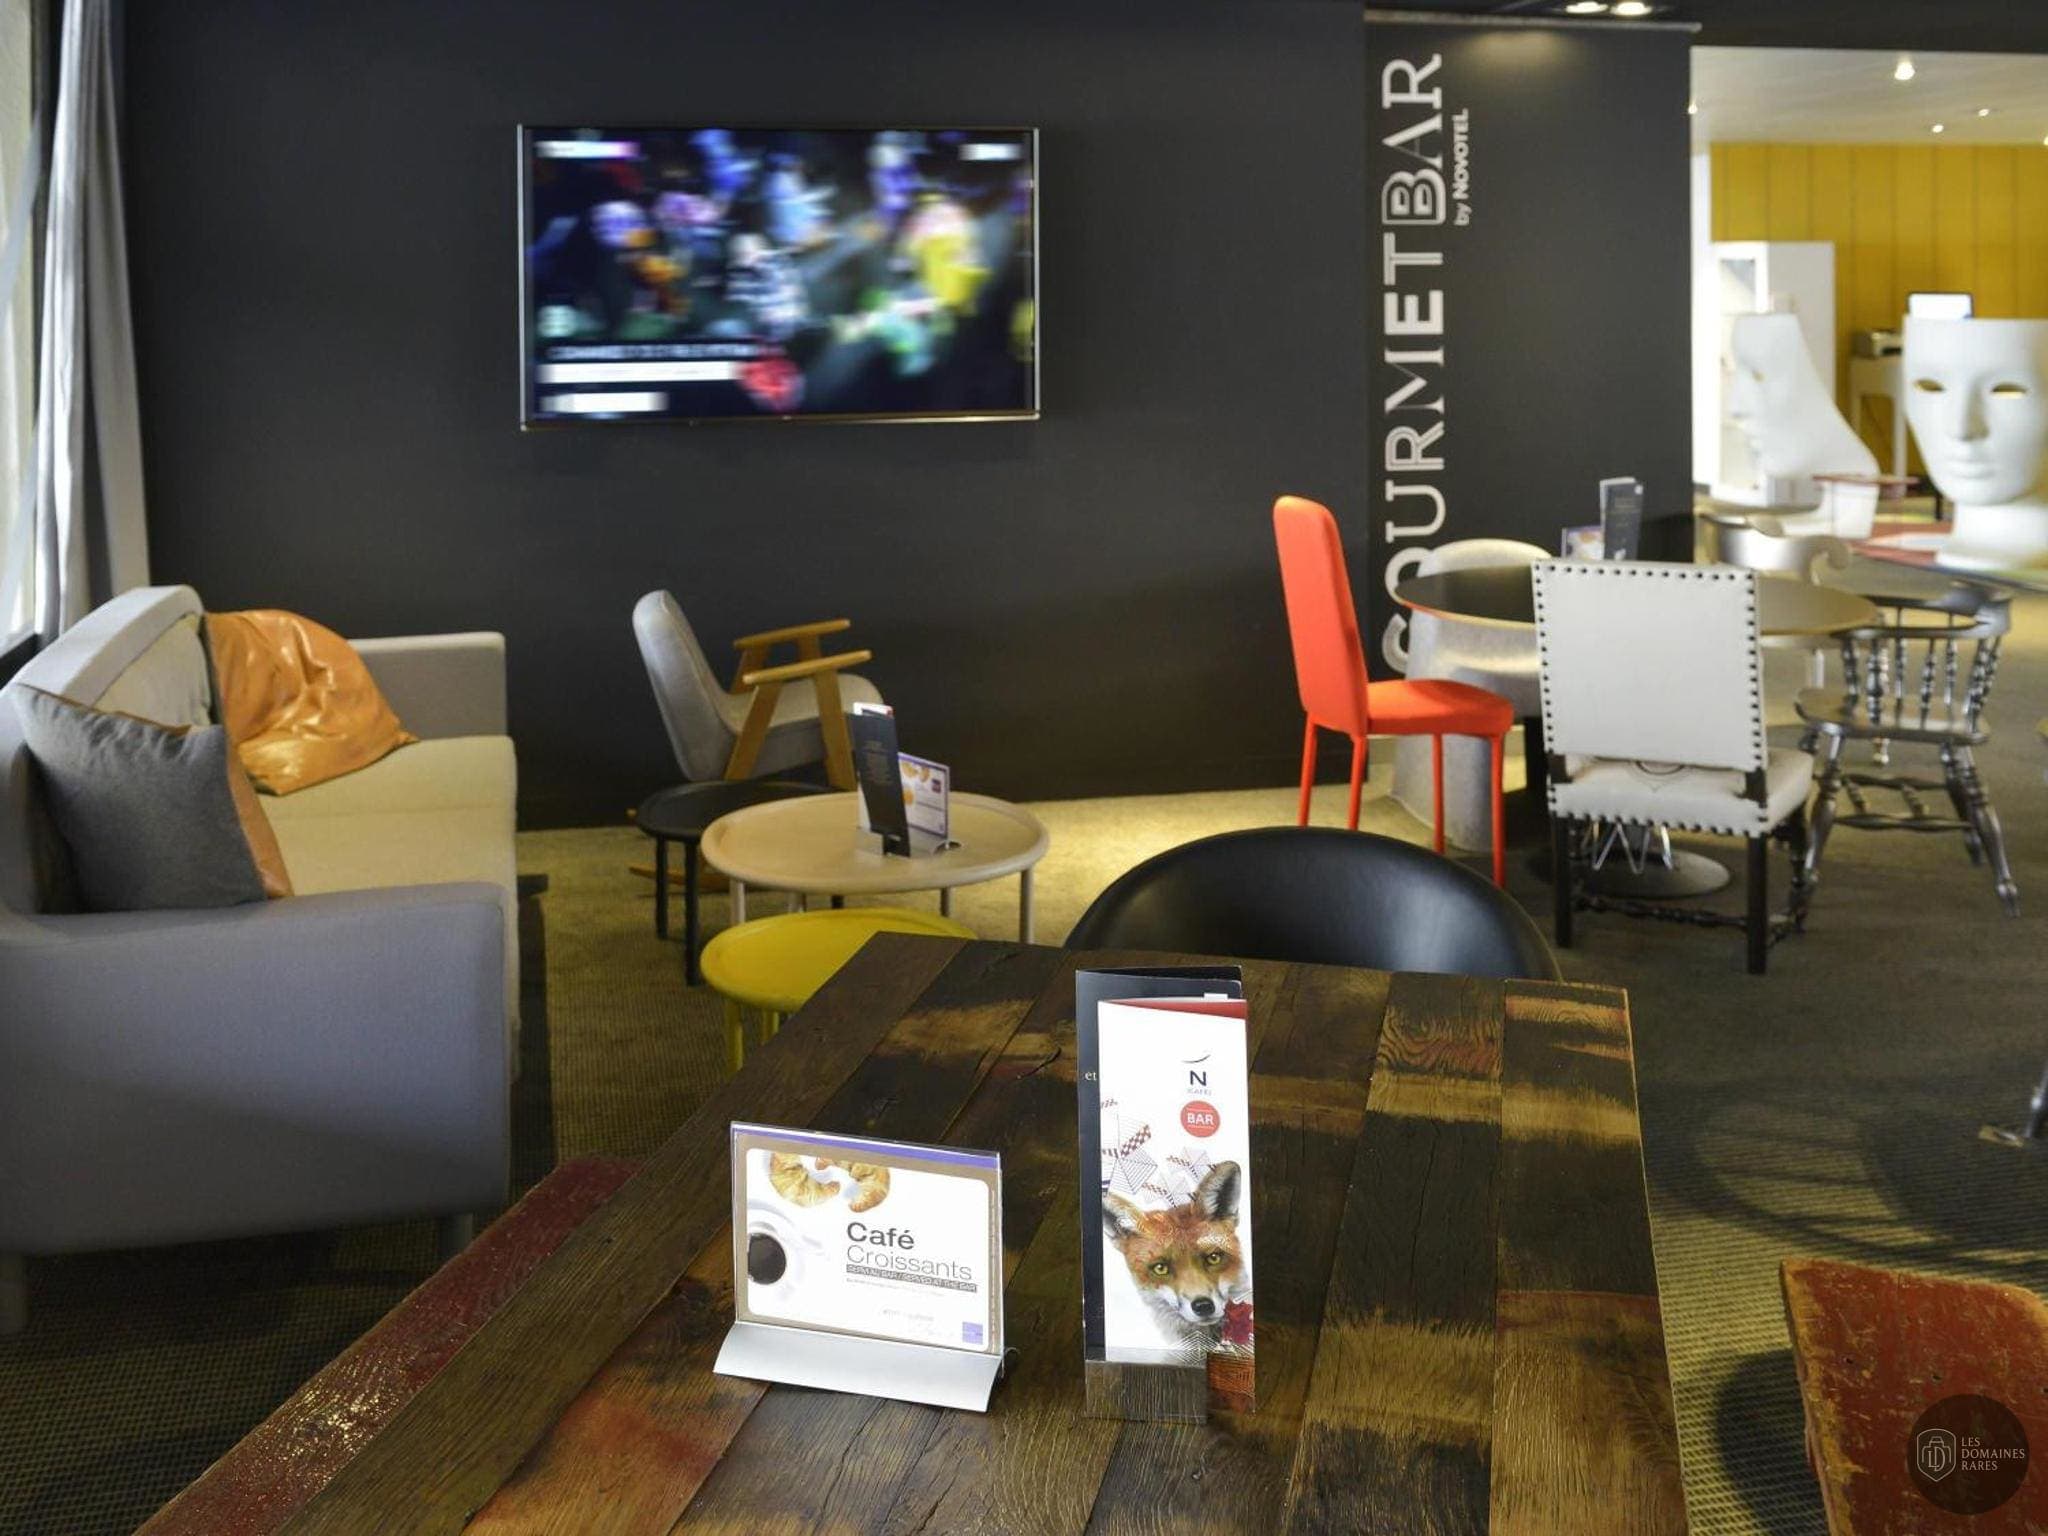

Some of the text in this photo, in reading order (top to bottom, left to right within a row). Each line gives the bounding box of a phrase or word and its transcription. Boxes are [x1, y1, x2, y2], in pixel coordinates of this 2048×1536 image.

[1453, 108, 1472, 226] by NOVOTEL
[1187, 1112, 1214, 1125] BAR
[846, 1221, 915, 1250] Café
[846, 1244, 972, 1281] Croissants
